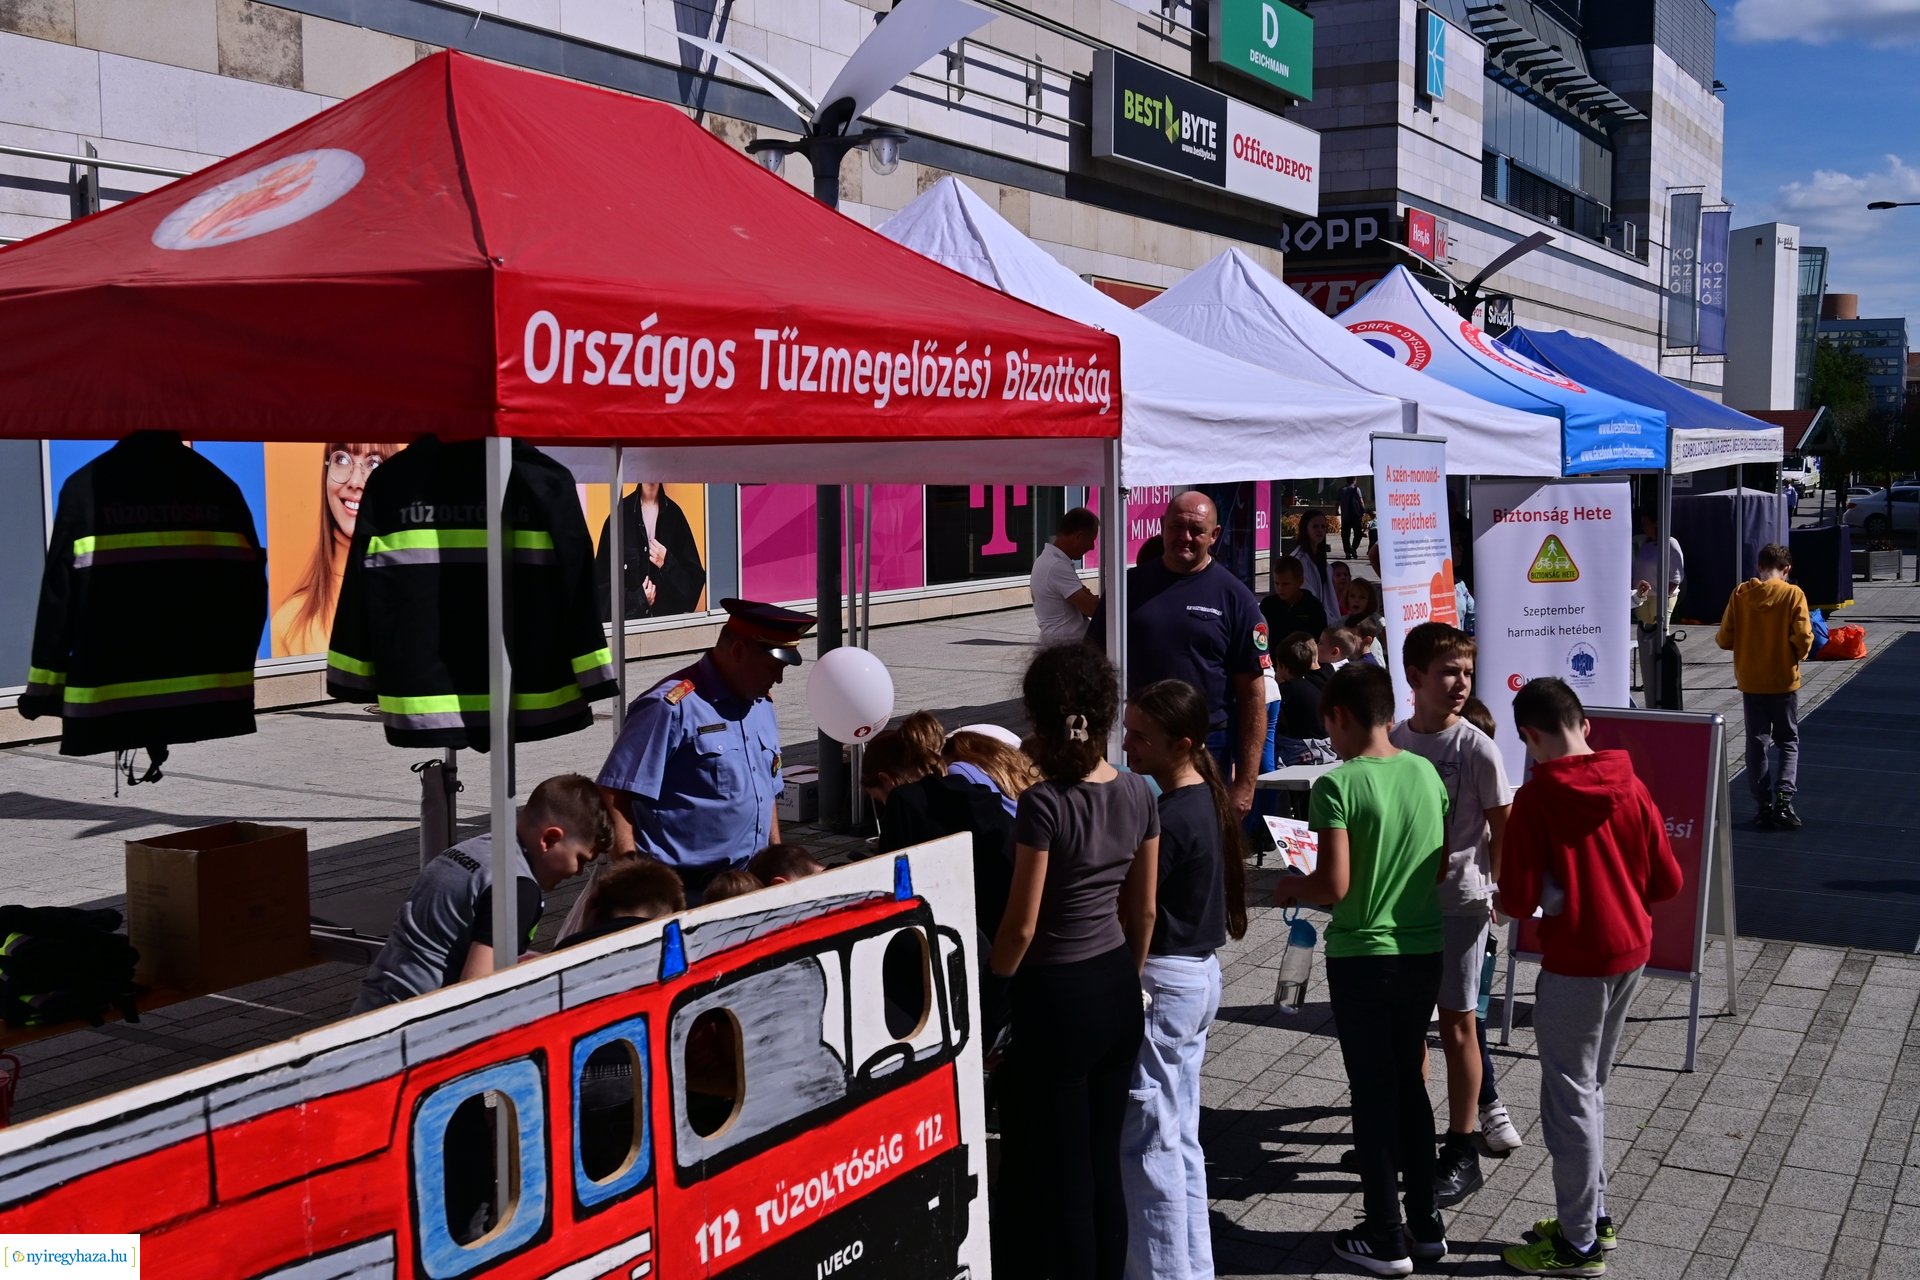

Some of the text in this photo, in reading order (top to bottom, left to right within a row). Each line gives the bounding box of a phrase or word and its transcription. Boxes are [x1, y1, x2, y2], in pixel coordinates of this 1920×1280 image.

[1250, 49, 1289, 78] DEICHMANN
[1124, 89, 1217, 149] BEST BYTE
[1233, 133, 1312, 183] Office DEPOT
[1357, 323, 1393, 331] ORFK
[524, 310, 1110, 415] Országos Tűzmegelőzési Bizottság
[1386, 465, 1391, 482] A
[1388, 488, 1421, 511] mérgezés
[1391, 512, 1437, 535] megelőzhető
[1493, 506, 1612, 524] Biztonság Hete
[1131, 519, 1143, 540] MI
[1530, 570, 1576, 580] BIZTONSÁG HETE
[1403, 602, 1428, 621] 200-300
[1523, 605, 1585, 619] Szeptember
[1508, 625, 1602, 638] harmadik hetében
[695, 1114, 943, 1265] 112 TŰZOLTÓSÁG 112
[817, 1240, 864, 1280] IVECO
